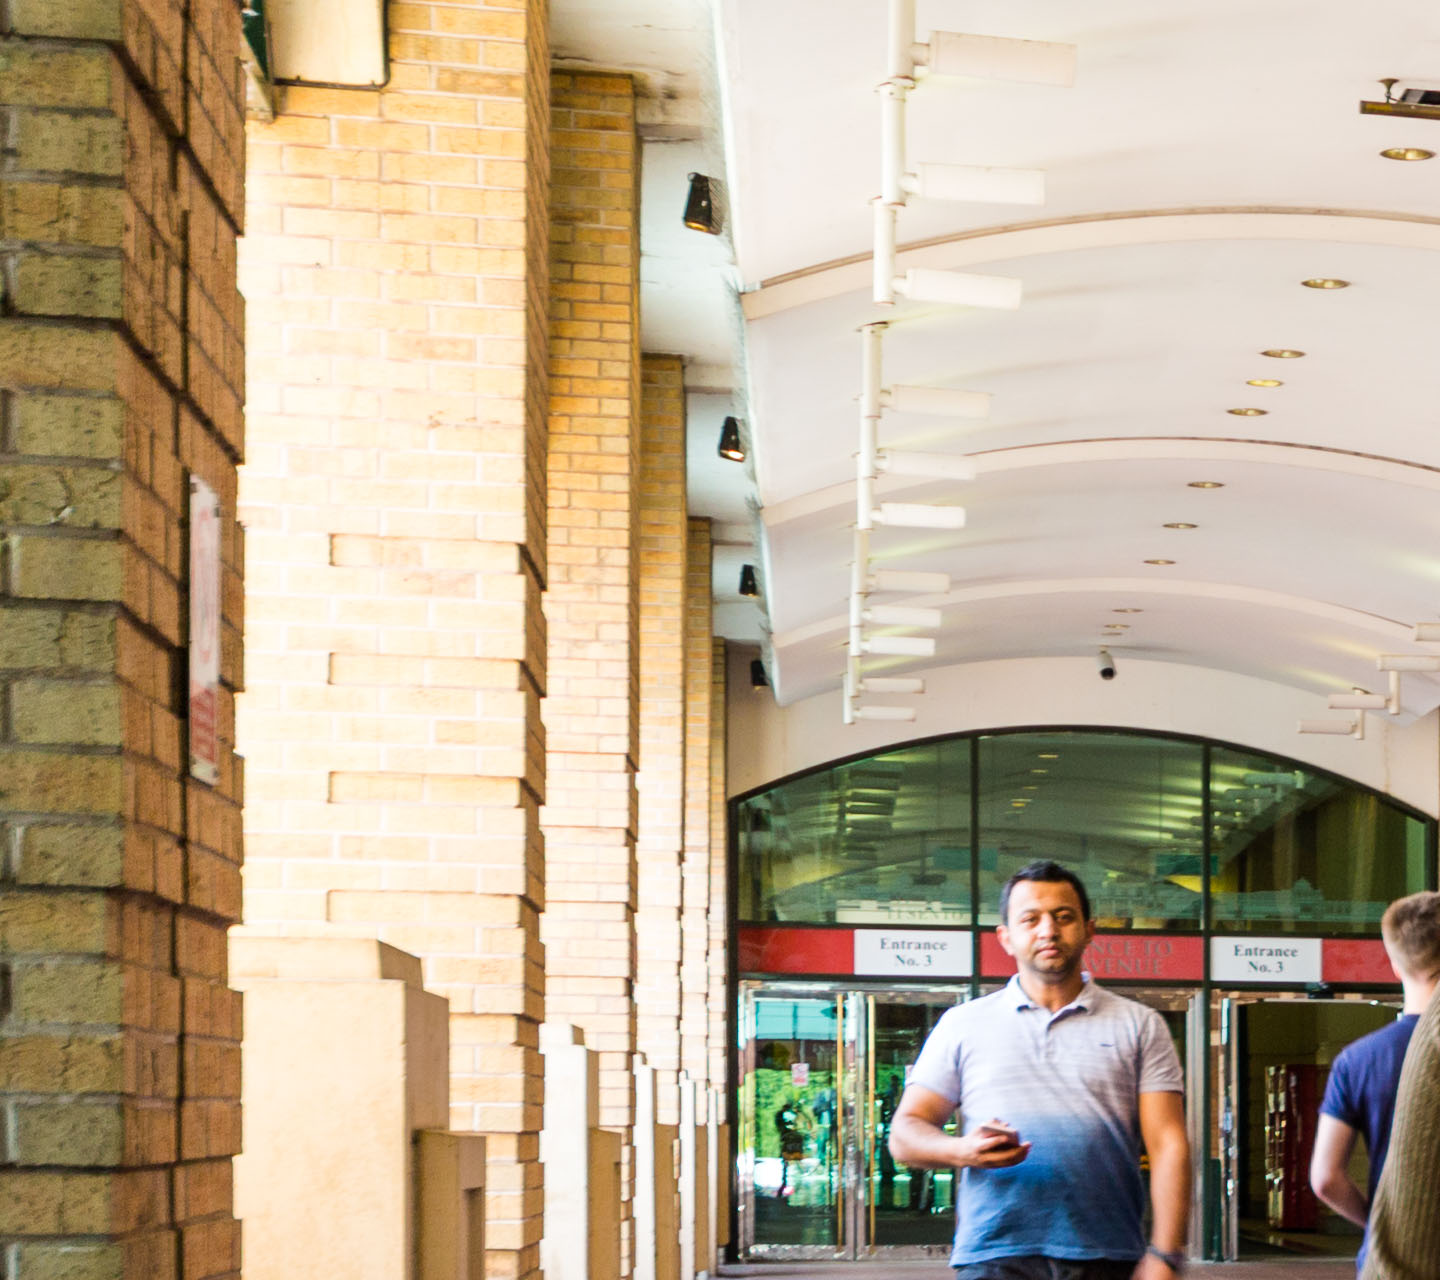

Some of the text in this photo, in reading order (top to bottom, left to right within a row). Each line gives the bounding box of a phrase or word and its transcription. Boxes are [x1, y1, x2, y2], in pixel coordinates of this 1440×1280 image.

[880, 937, 948, 952] Entrance
[1143, 939, 1173, 957] TO
[1233, 943, 1299, 958] Entrance
[894, 955, 933, 967] No. 3
[1247, 961, 1284, 973] No. 3
